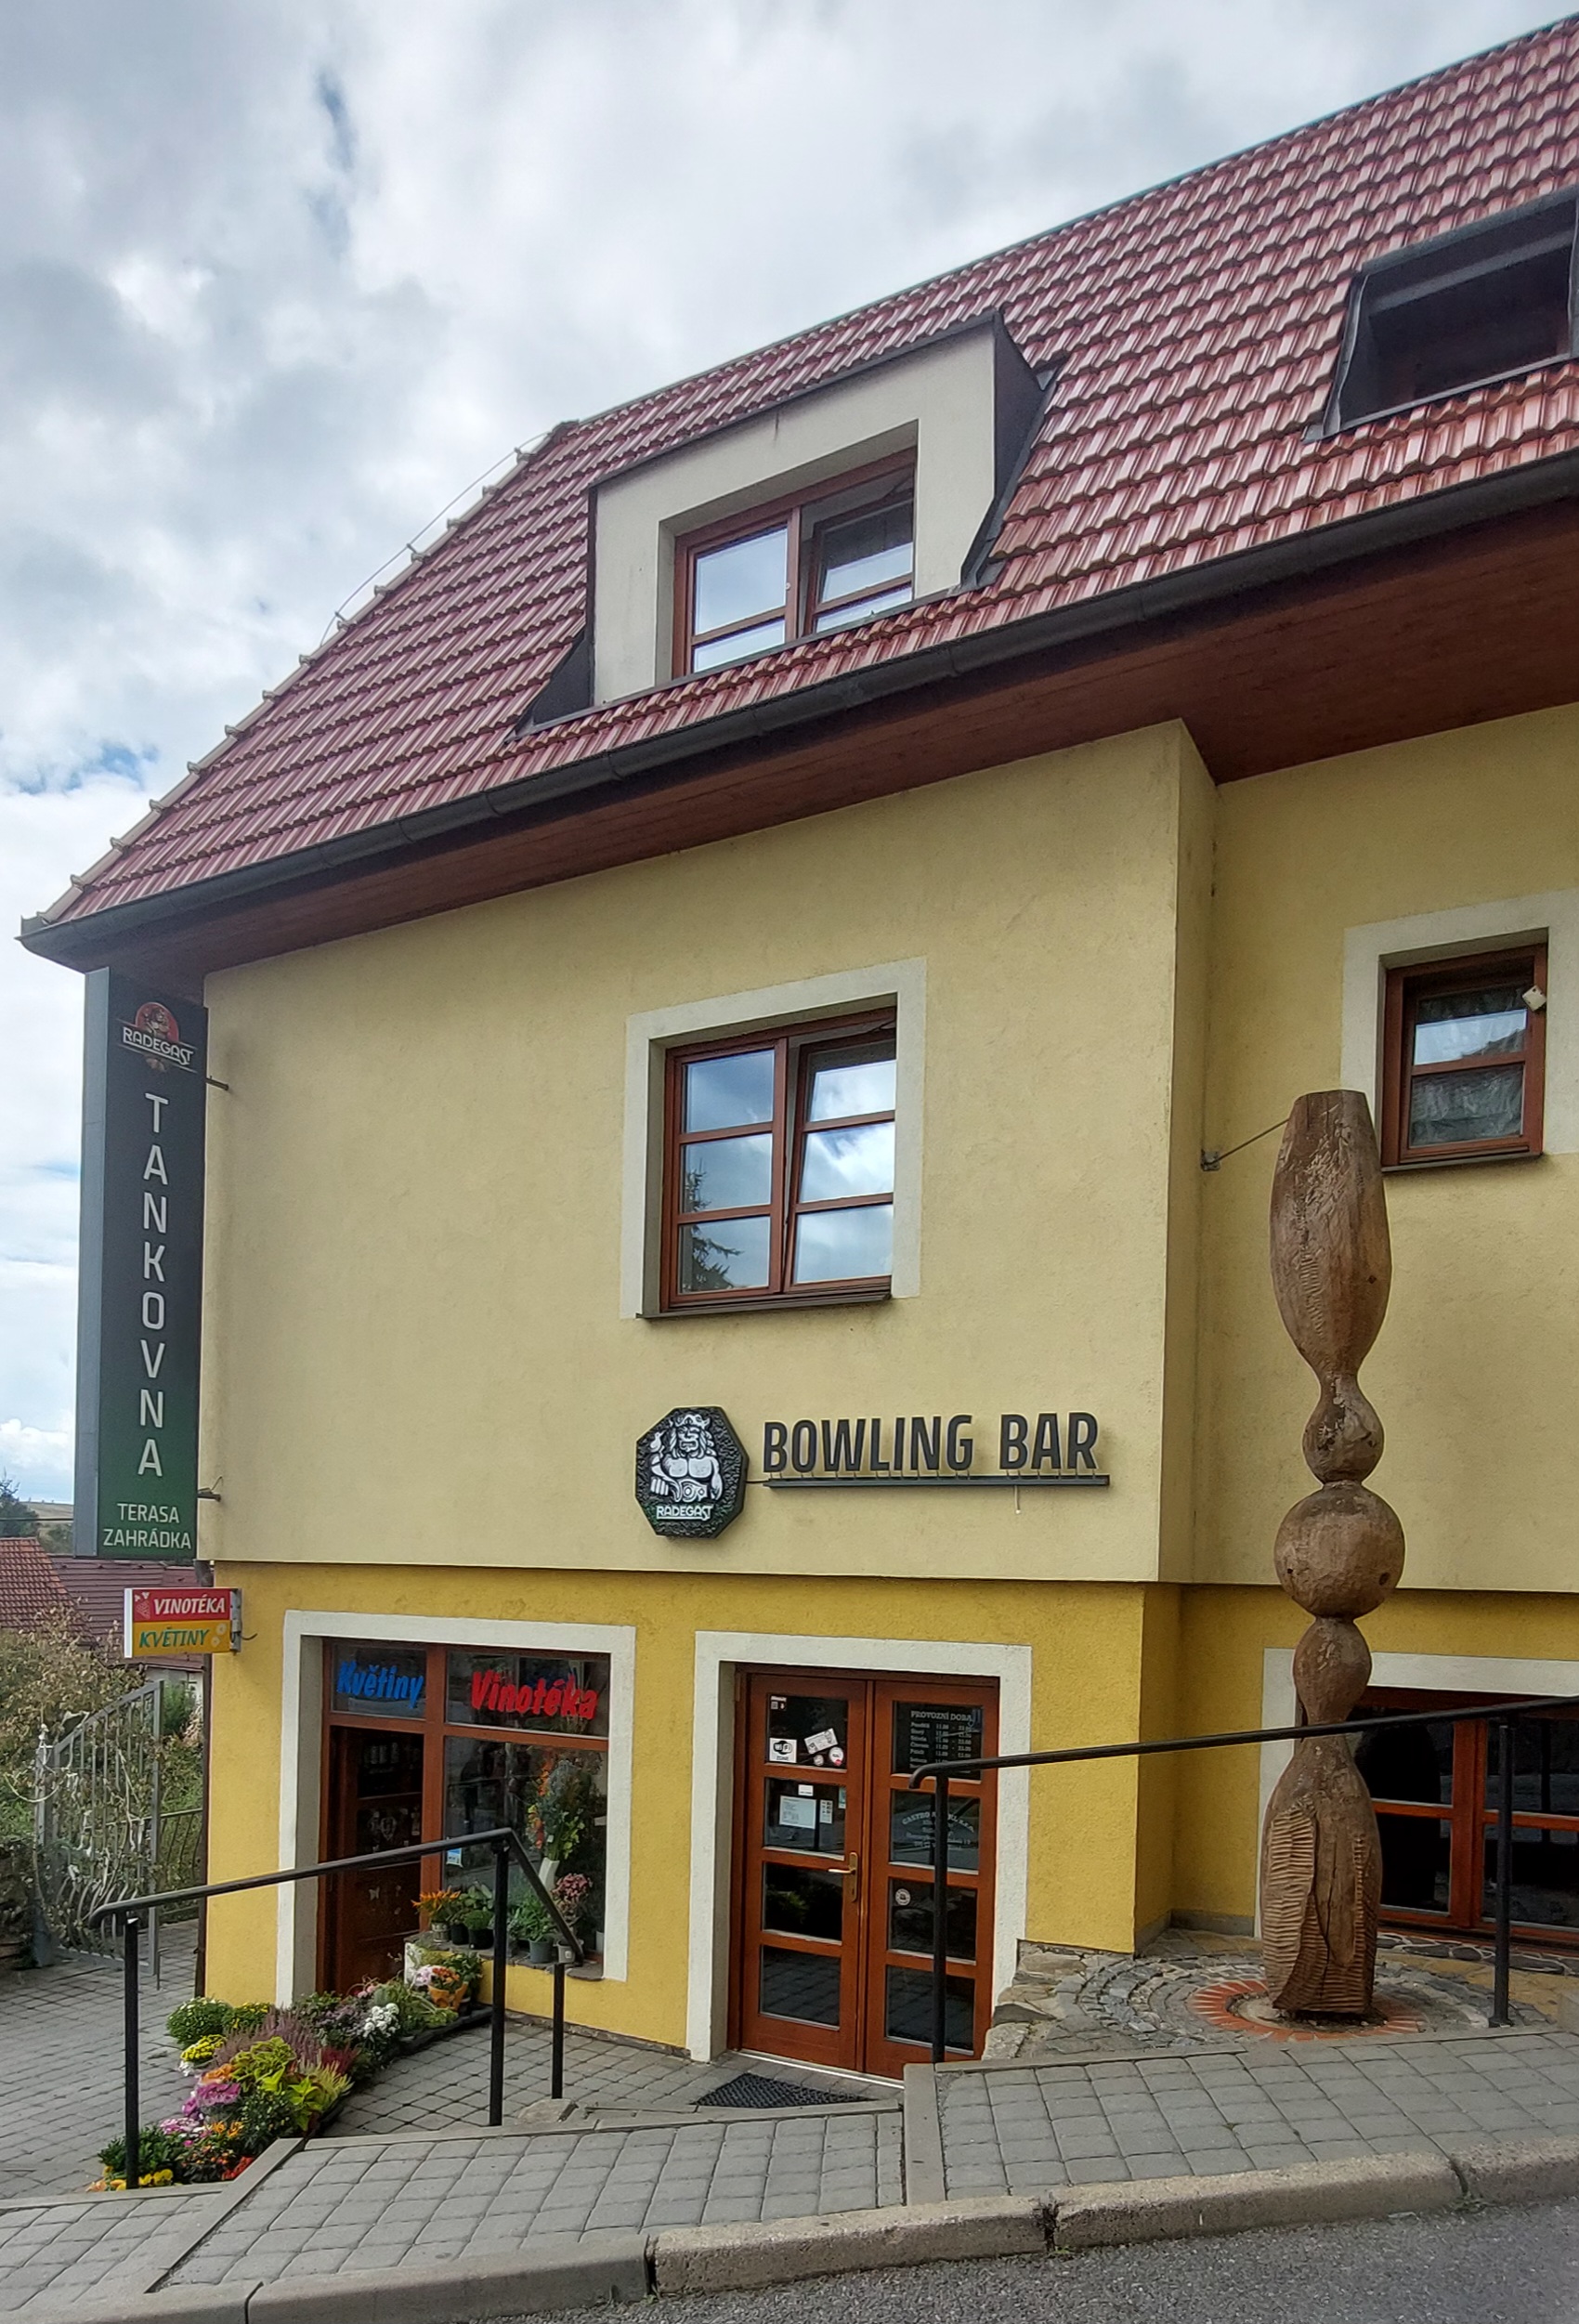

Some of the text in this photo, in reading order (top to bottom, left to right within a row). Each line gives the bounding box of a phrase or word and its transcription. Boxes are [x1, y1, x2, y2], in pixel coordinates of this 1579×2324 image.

[123, 1025, 194, 1066] RADEGAST
[137, 1092, 169, 1477] TANKOVNA
[763, 1412, 1100, 1473] BOWLING BAR
[117, 1503, 180, 1523] TERASA
[656, 1505, 713, 1521] RADEGAST
[103, 1528, 191, 1549] ZAHRÁDKA
[153, 1594, 226, 1614] VINOTÉKA
[139, 1626, 210, 1648] KVĚTINY
[336, 1660, 424, 1709] Květiny
[472, 1669, 599, 1720] Vinotéka
